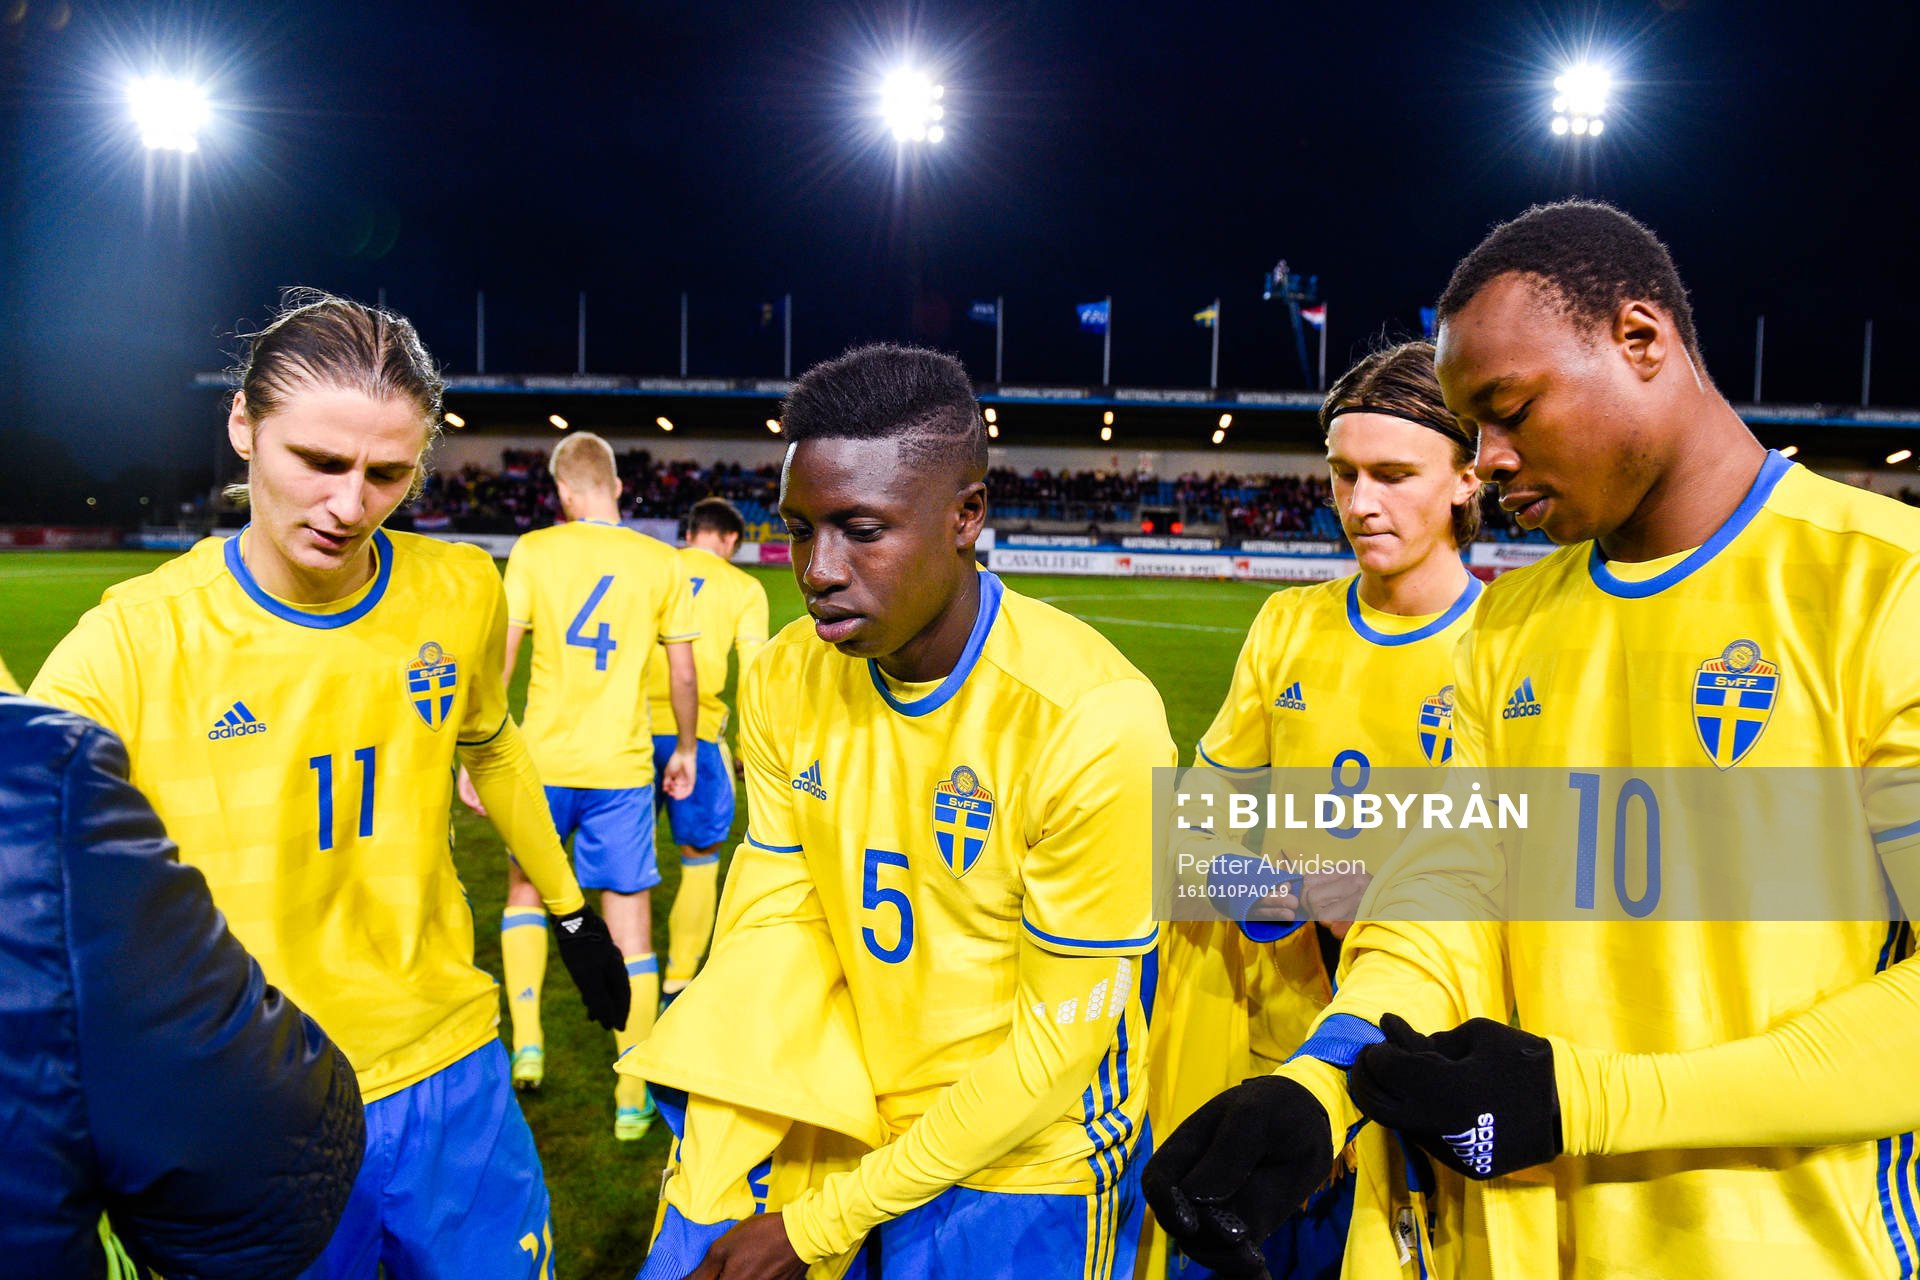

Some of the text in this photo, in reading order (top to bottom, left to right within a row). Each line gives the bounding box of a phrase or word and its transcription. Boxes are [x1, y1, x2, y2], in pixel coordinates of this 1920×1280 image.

[996, 554, 1090, 569] CAVALIERE
[566, 575, 617, 671] 4
[419, 667, 447, 679] SvFF
[1714, 676, 1758, 688] SvFF
[1502, 701, 1541, 720] adidas
[208, 720, 267, 740] adidas
[309, 746, 375, 851] 11
[791, 778, 827, 801] adidas
[1323, 749, 1371, 840] 8
[949, 797, 979, 810] SvFF
[1569, 772, 1661, 918] 10
[862, 848, 914, 964] 5
[1475, 1112, 1495, 1174] adidas
